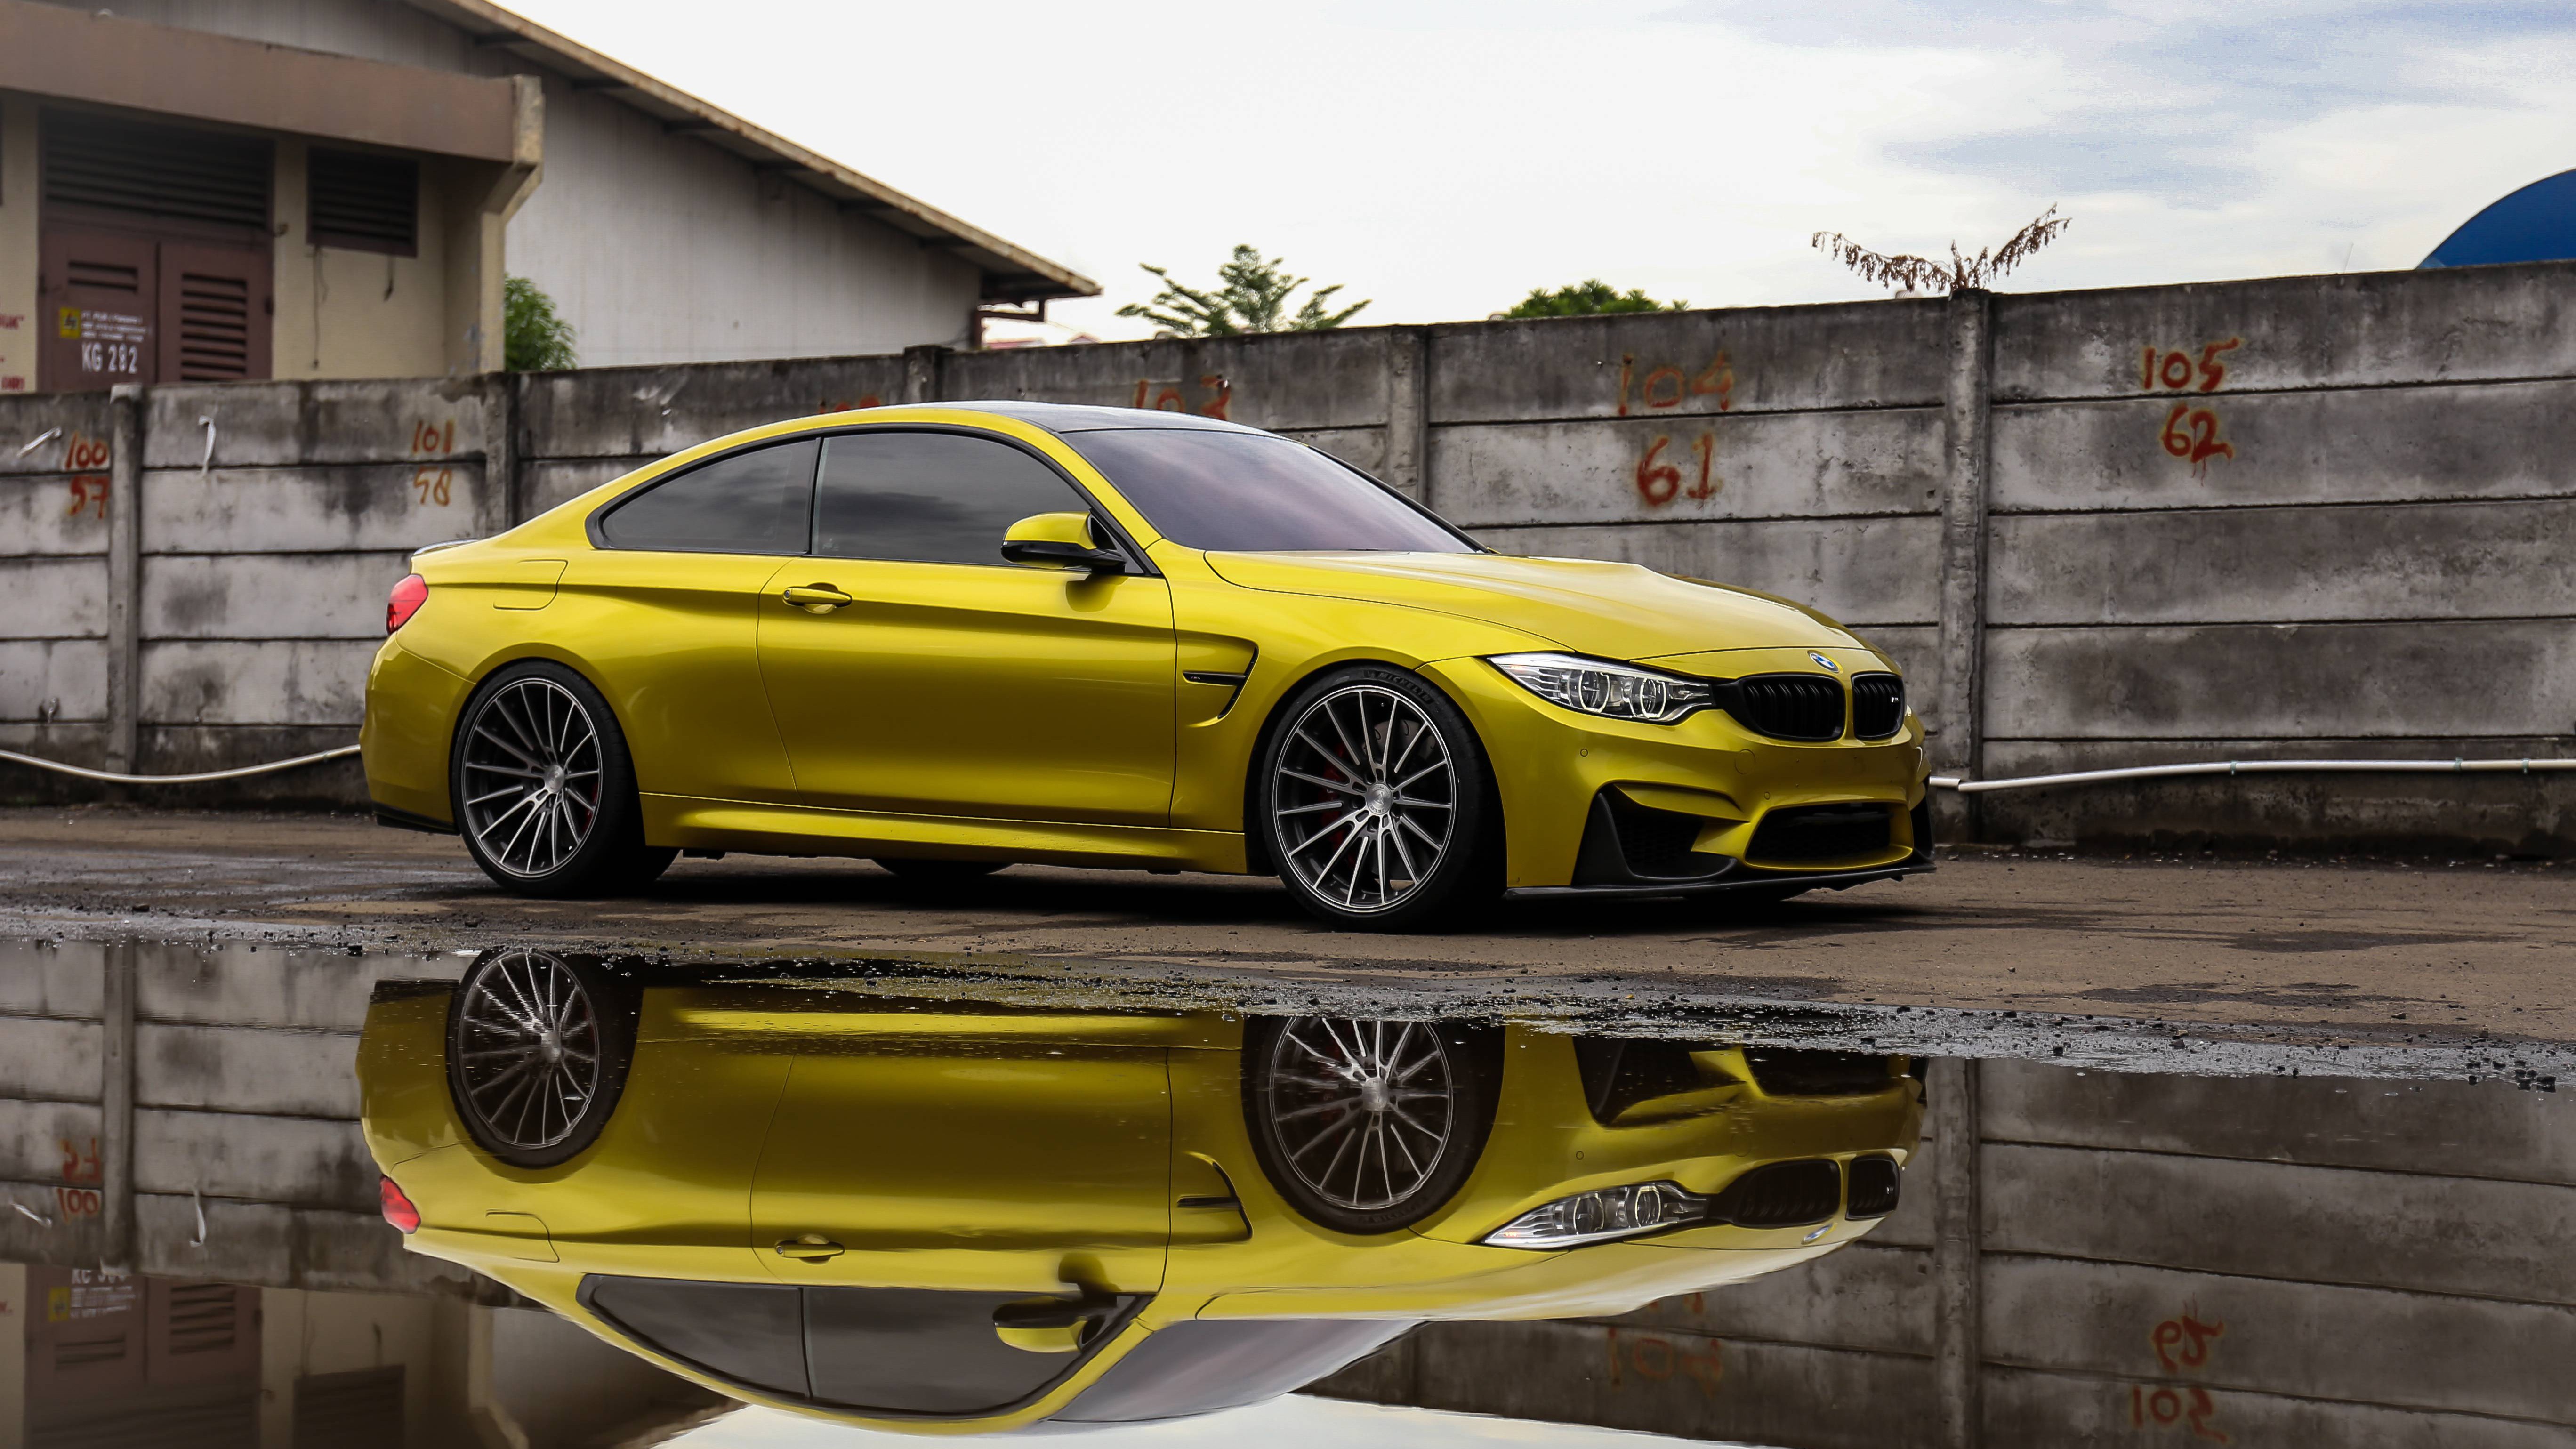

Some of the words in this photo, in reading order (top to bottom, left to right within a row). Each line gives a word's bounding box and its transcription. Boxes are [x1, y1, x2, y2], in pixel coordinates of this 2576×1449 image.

[82, 342, 103, 372] KG
[108, 343, 137, 374] 282
[2142, 337, 2242, 392] 105
[1618, 352, 1733, 416] 104
[65, 431, 108, 470] 100
[412, 419, 454, 455] 101
[2162, 403, 2235, 464] 62
[1636, 433, 1723, 507] 61
[69, 476, 110, 519] 57
[1378, 672, 1430, 702] MICHELIN
